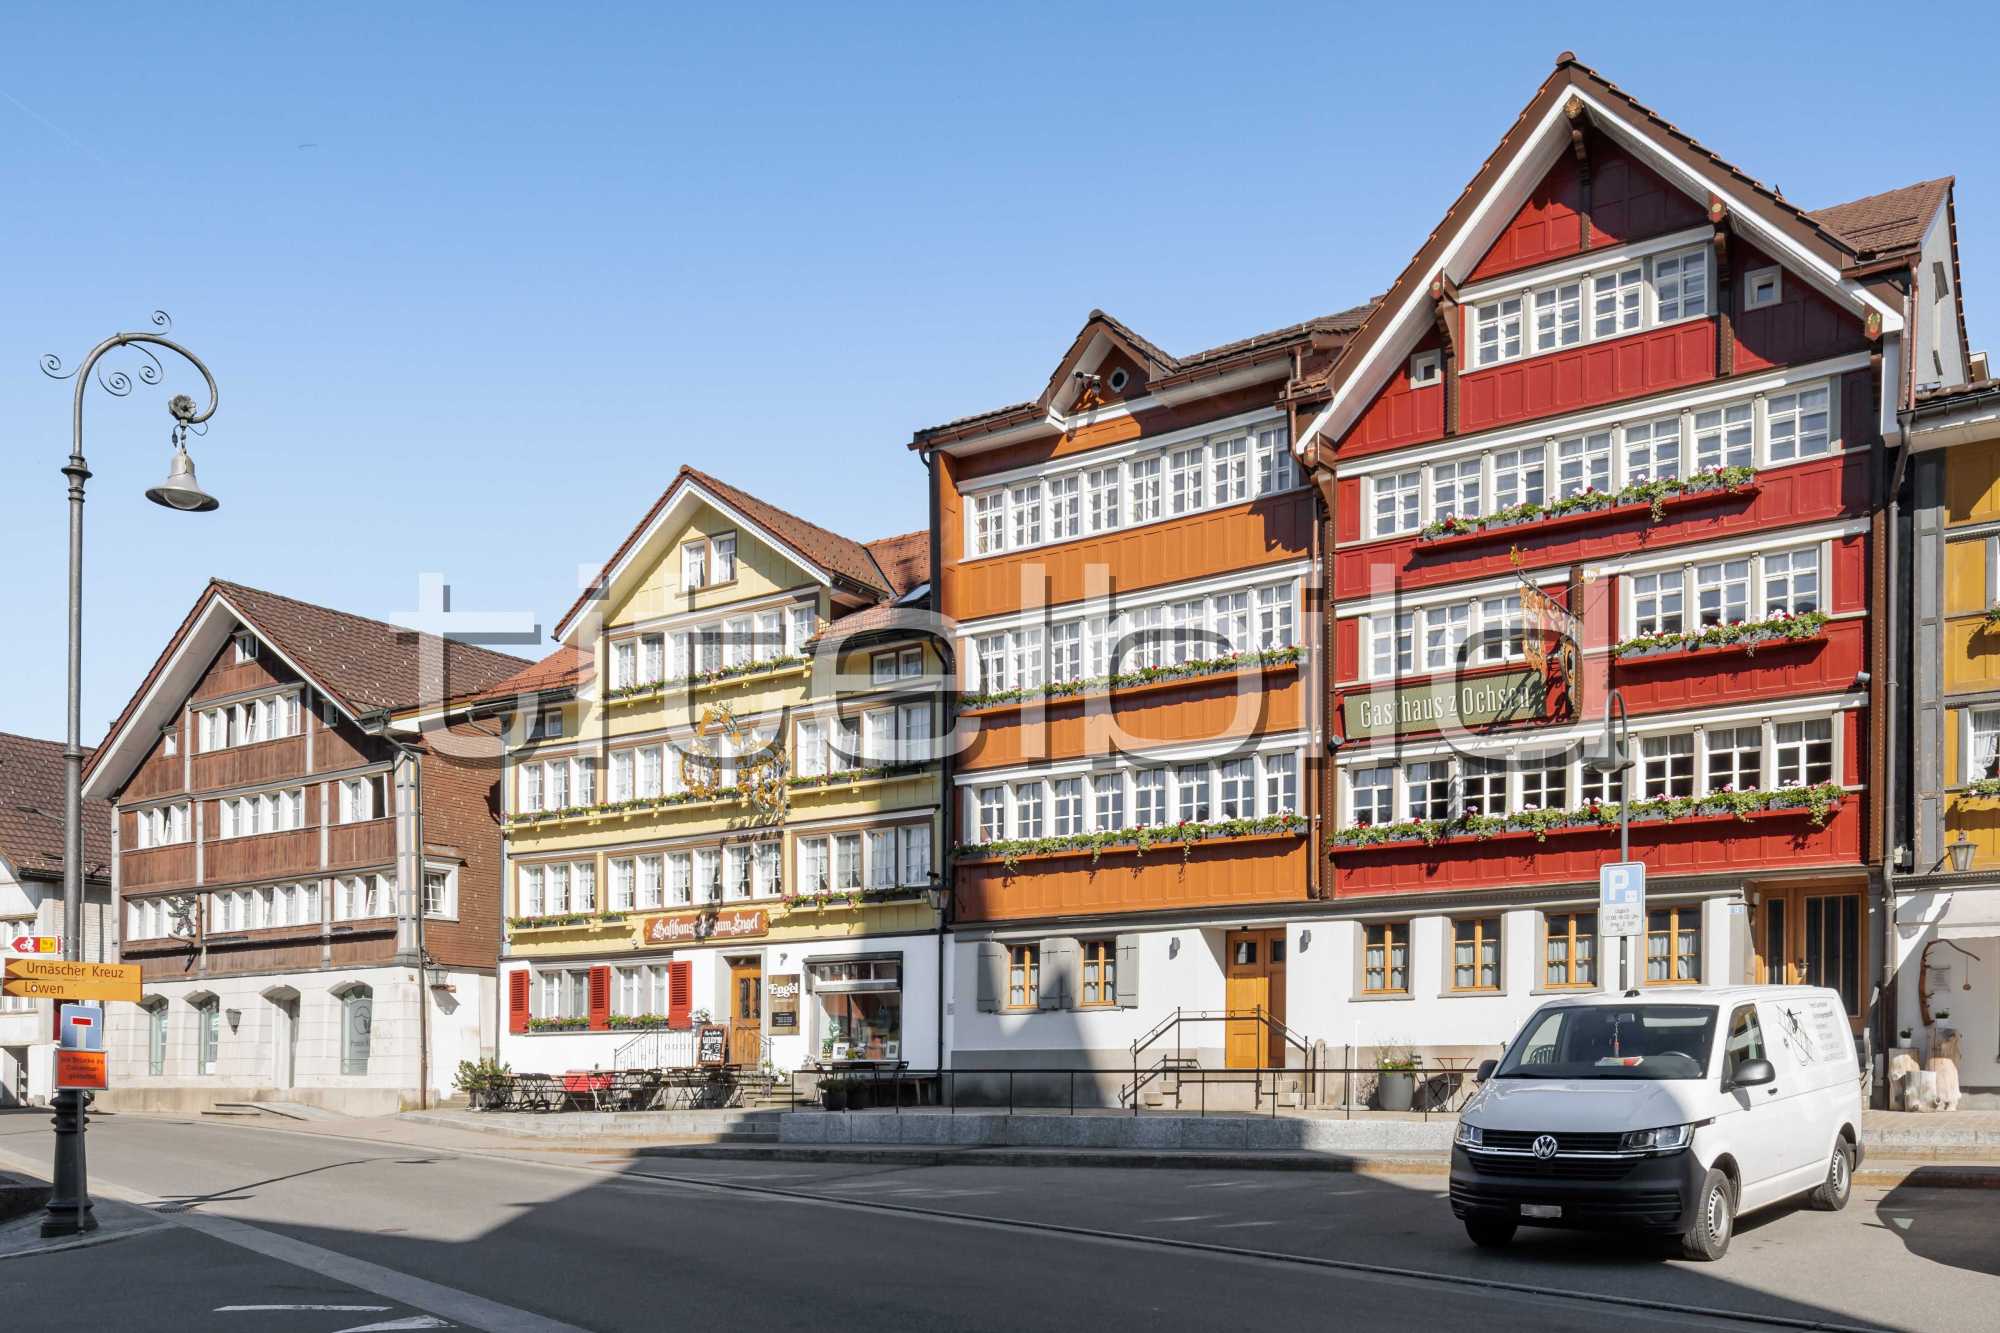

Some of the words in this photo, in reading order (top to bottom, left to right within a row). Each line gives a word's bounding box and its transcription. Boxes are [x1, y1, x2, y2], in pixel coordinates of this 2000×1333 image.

[1360, 695, 1444, 728] Gasthaus
[1461, 684, 1530, 716] Ochsen
[1608, 869, 1630, 901] P
[26, 962, 86, 976] Urnäscher
[92, 965, 124, 979] Kreuz
[24, 981, 64, 995] Löwen
[769, 983, 799, 998] Engel
